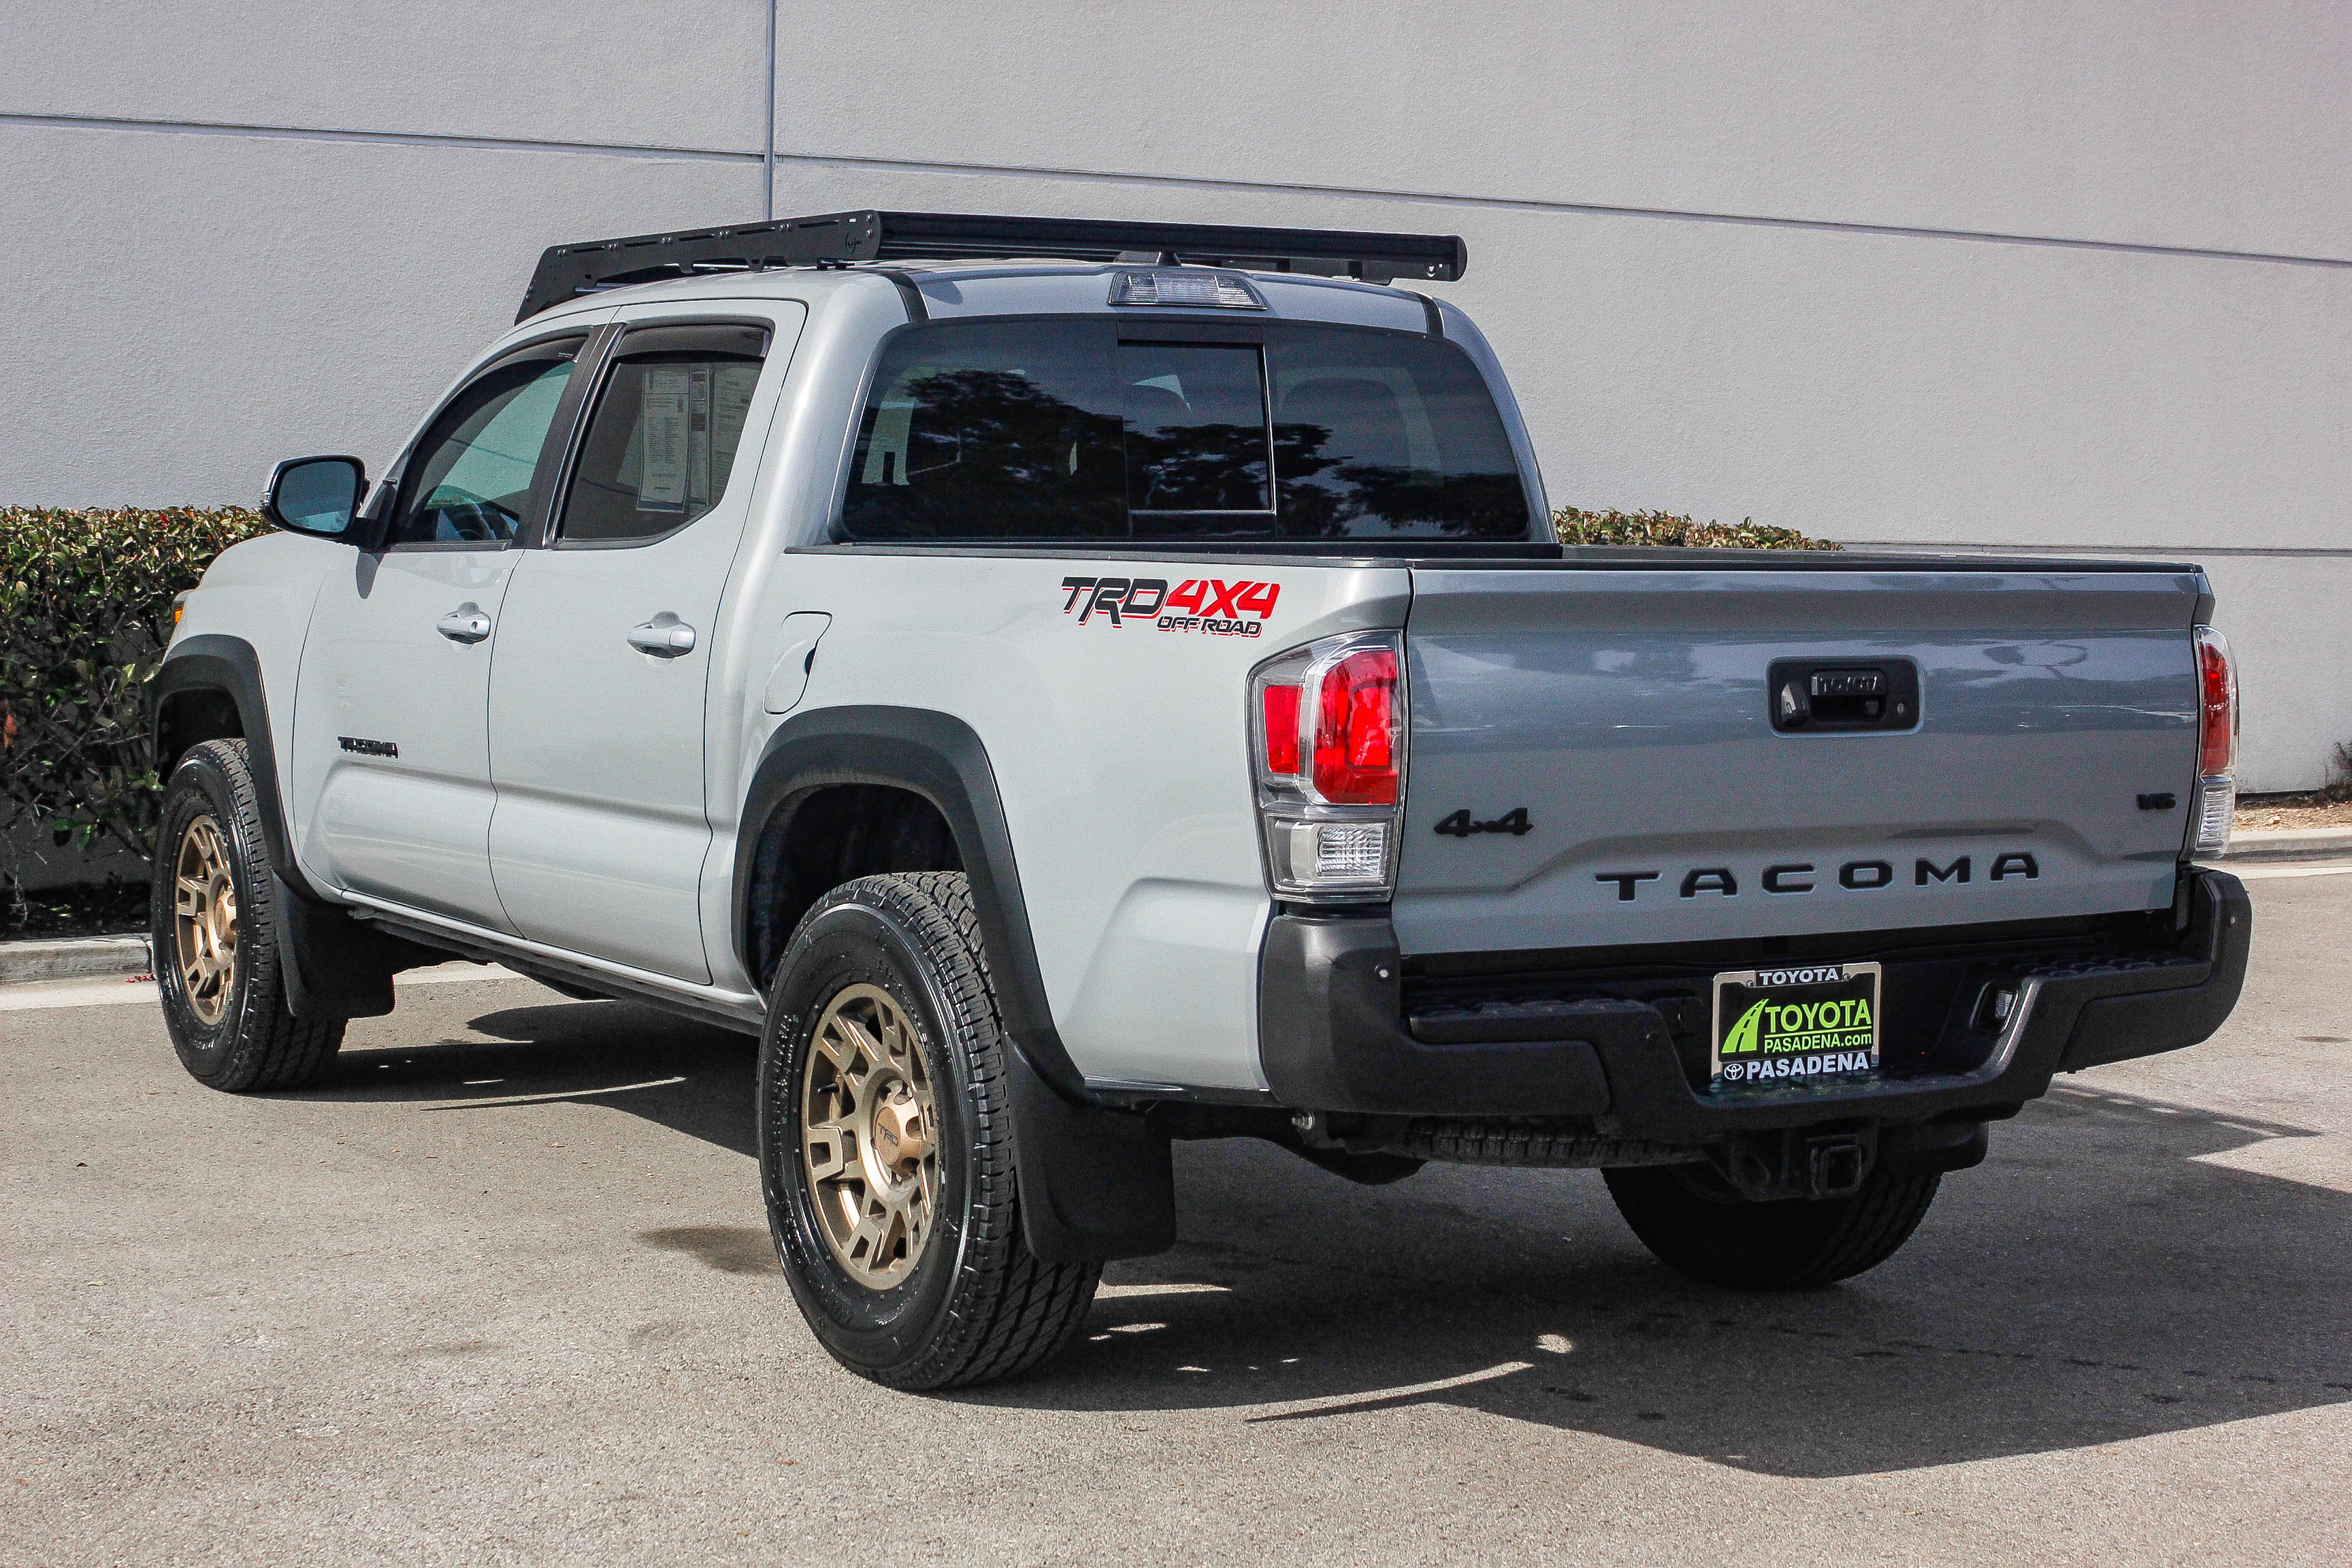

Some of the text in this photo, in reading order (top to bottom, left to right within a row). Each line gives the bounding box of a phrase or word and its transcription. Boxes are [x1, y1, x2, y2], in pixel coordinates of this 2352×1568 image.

[1061, 576, 1169, 629] TRD
[1156, 616, 1262, 638] OFF ROAD
[1595, 851, 2040, 902] TACOMA
[1759, 968, 1839, 985] TOYOTA
[1765, 998, 1872, 1034] TOYOTA
[1764, 1032, 1872, 1054] PASADENA.com
[1746, 1052, 1869, 1080] PASADENA
